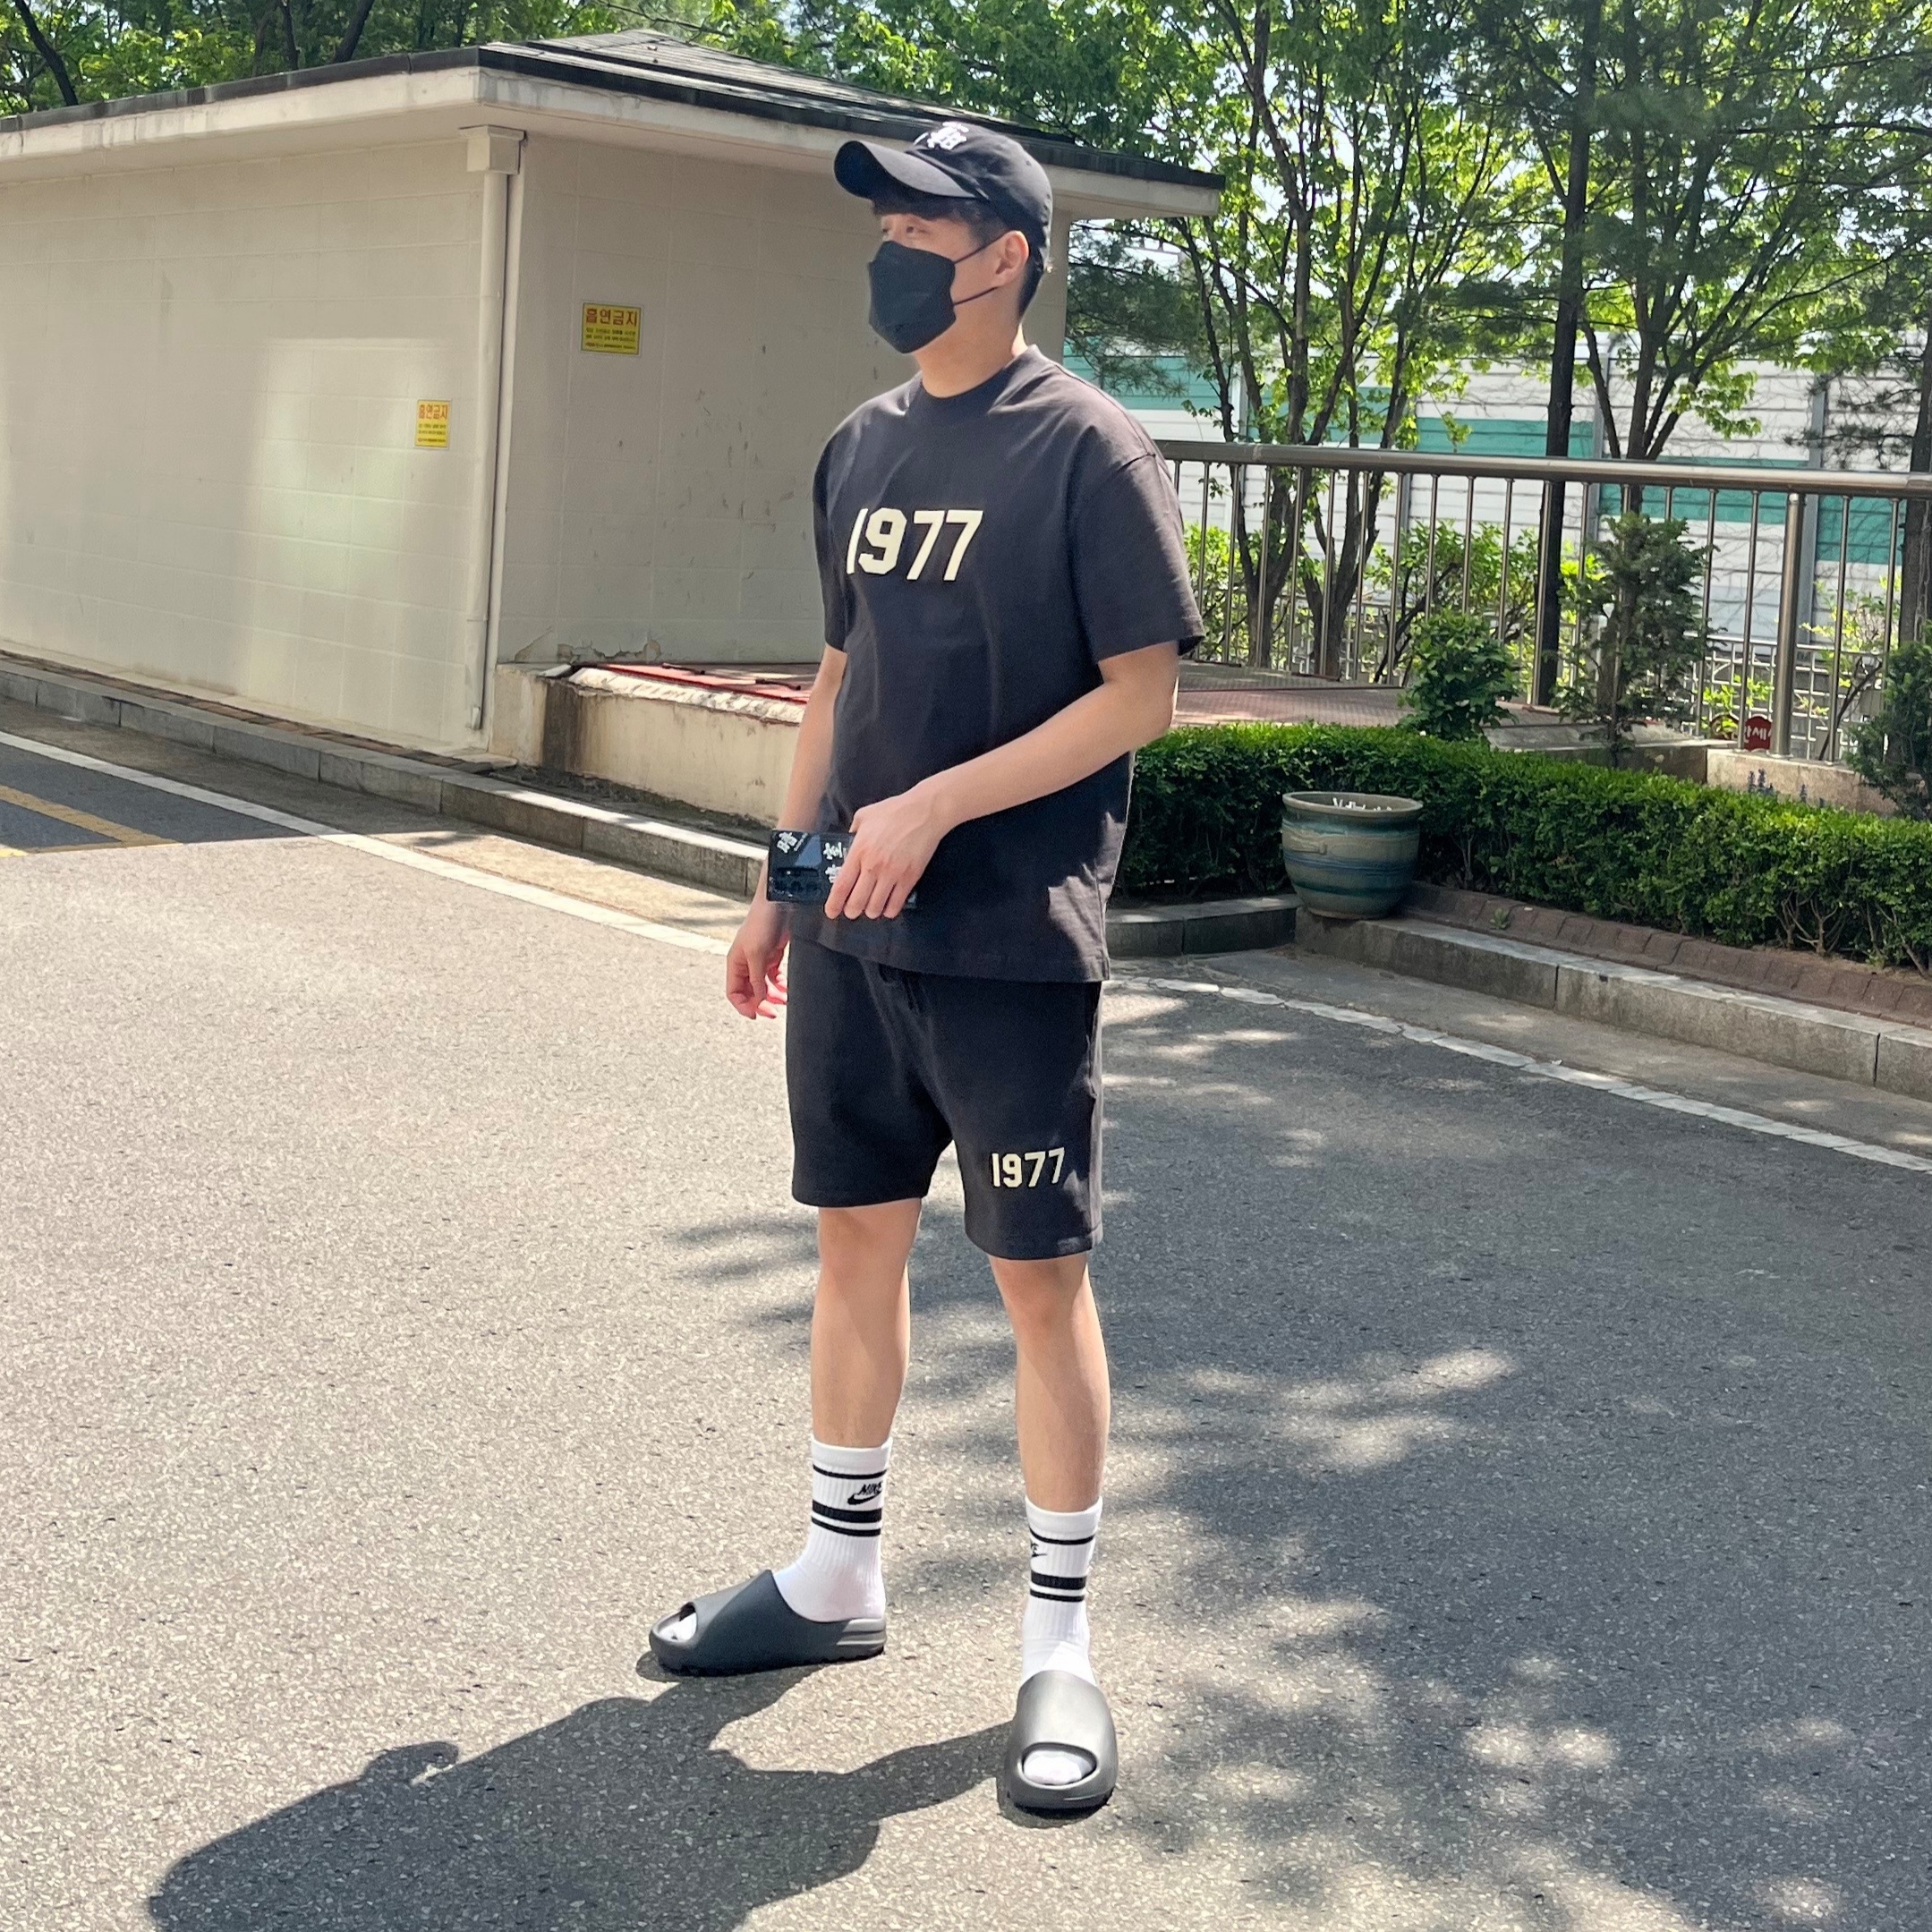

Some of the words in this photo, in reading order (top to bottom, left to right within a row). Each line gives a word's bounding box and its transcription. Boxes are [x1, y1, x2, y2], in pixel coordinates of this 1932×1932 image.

[585, 306, 638, 327] 흡연금지
[847, 507, 983, 581] 1977
[992, 1147, 1065, 1187] 1977
